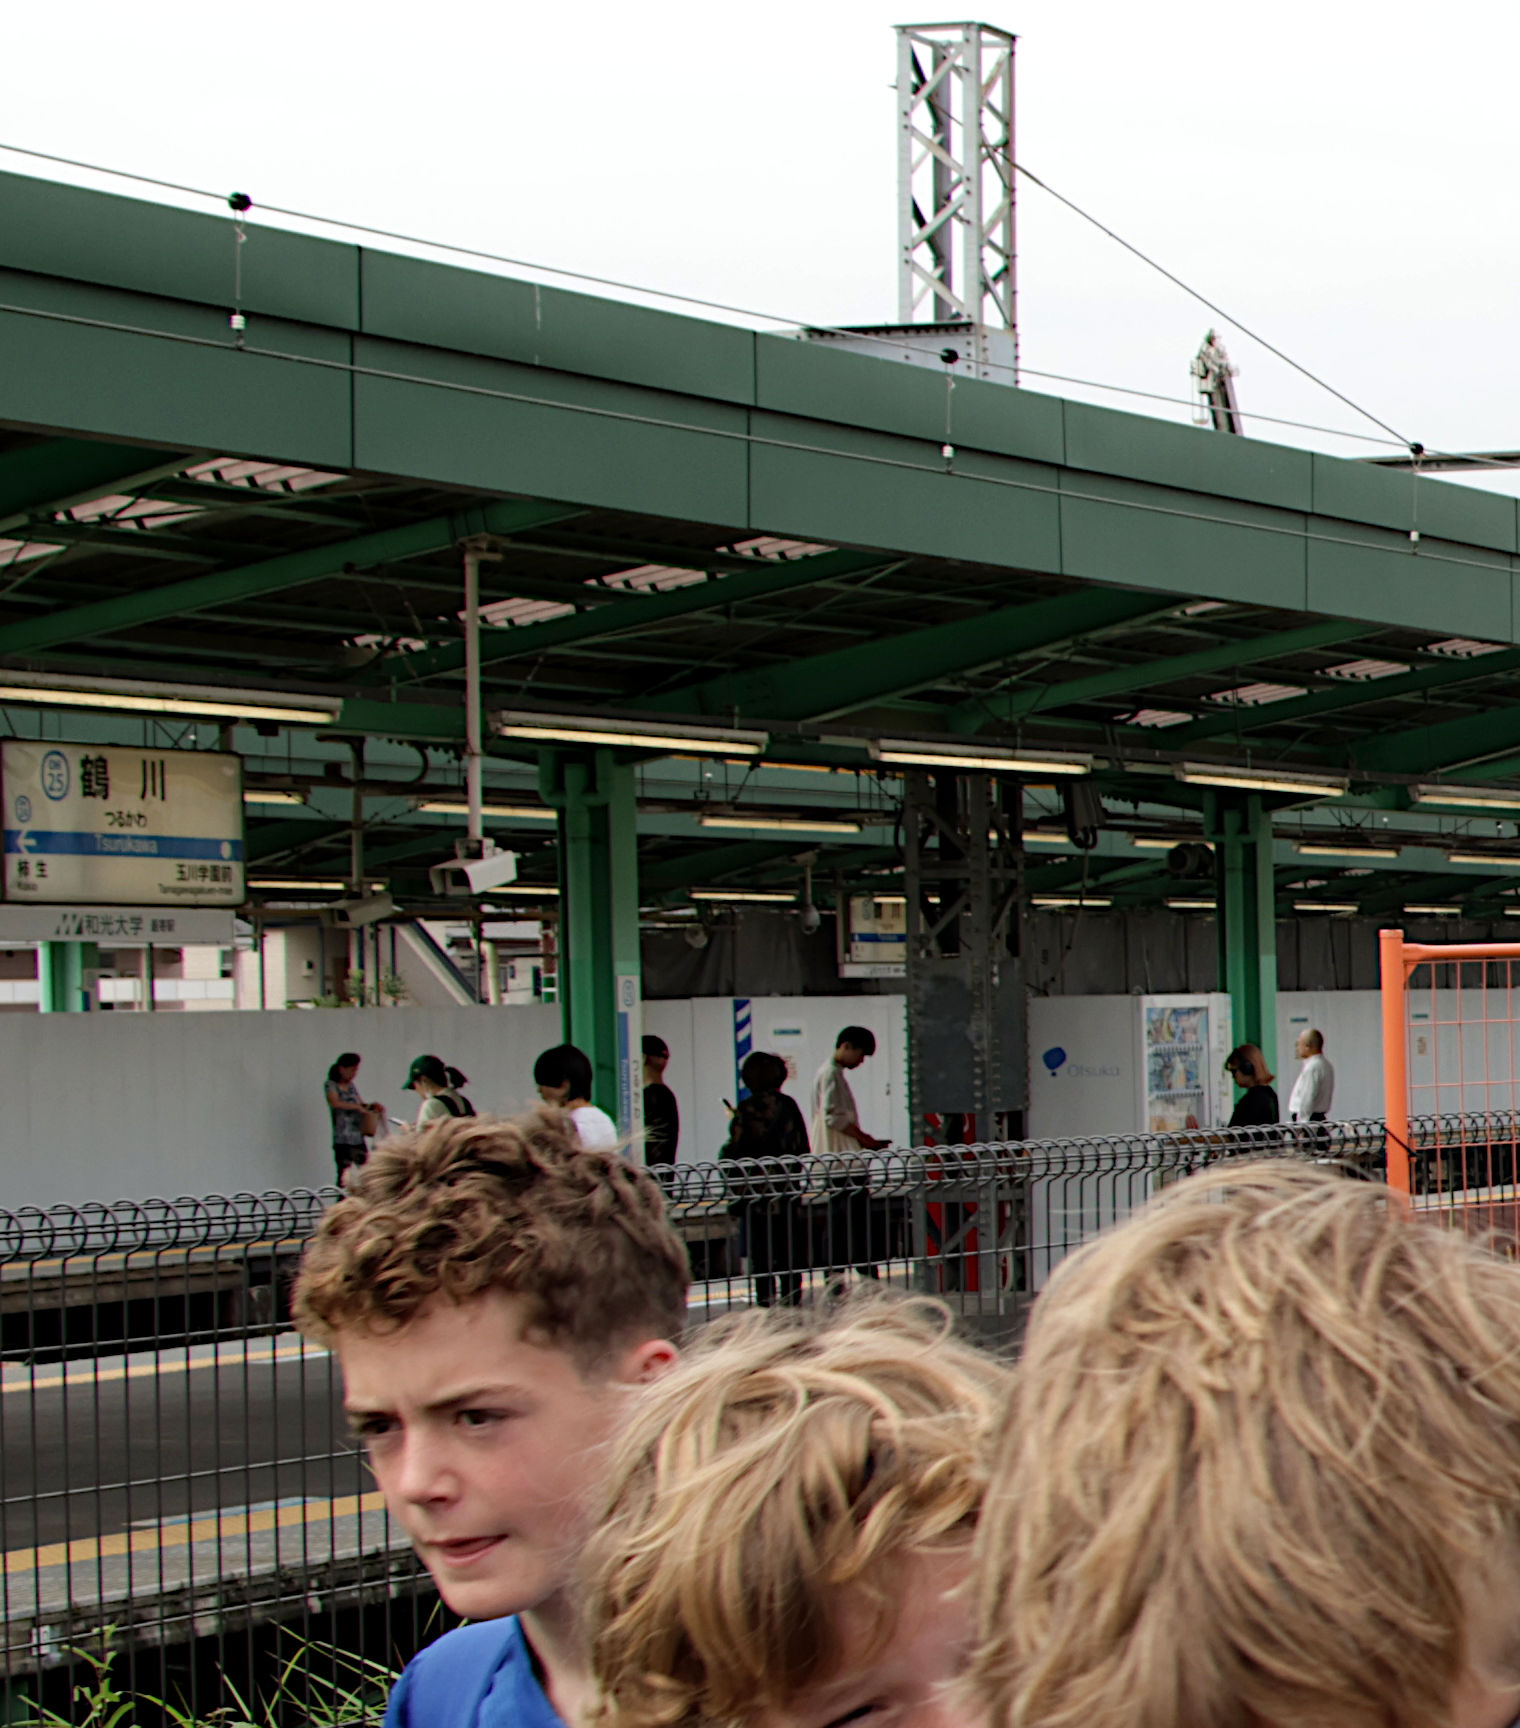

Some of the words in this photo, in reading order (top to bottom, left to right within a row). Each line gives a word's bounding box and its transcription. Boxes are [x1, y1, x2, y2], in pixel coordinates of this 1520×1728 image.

[48, 774, 64, 792] 25
[80, 754, 166, 801] 鶴川
[104, 811, 148, 828] つるかわ
[86, 914, 143, 935] 和光大学
